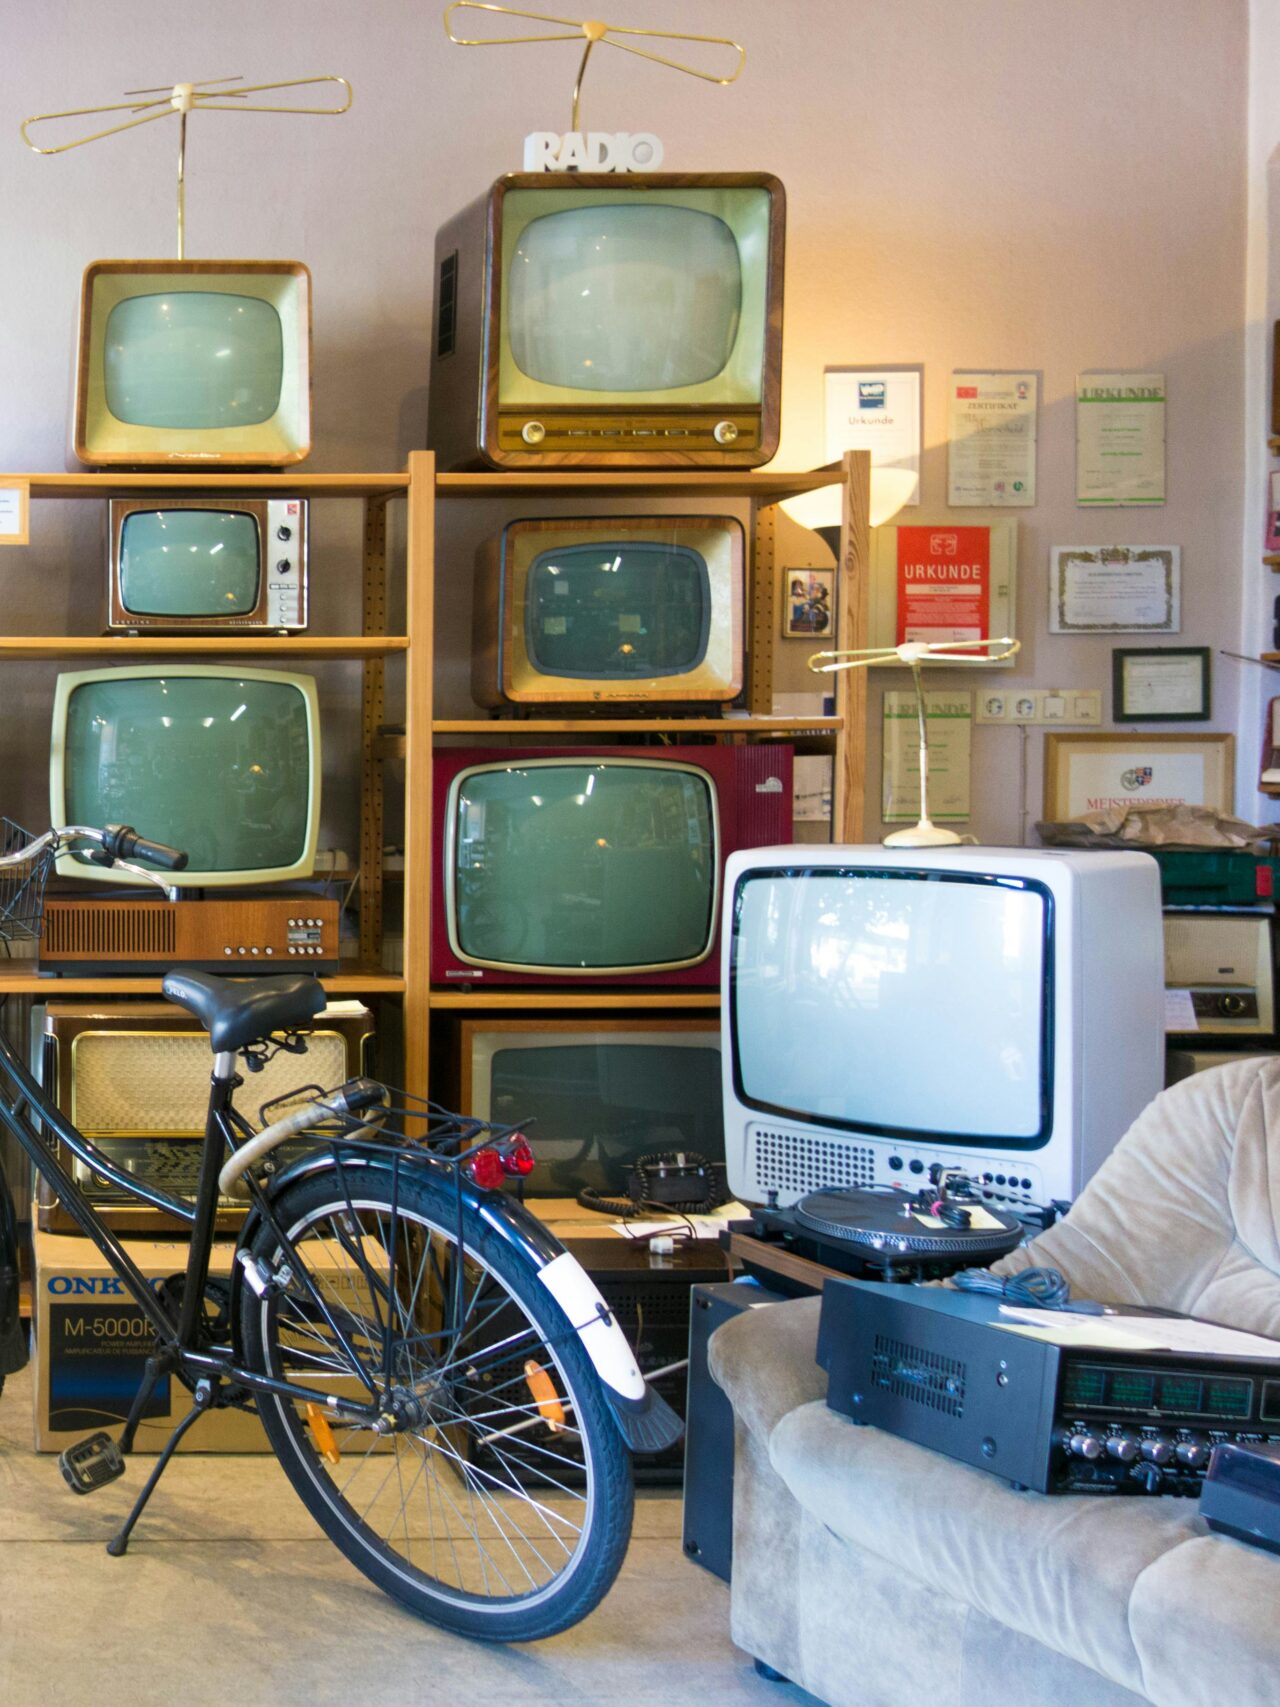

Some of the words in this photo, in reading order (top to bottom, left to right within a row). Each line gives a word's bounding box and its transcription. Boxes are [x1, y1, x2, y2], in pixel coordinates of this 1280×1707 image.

[523, 132, 664, 172] RADIO
[1081, 387, 1162, 398] URKUNDE
[848, 415, 895, 425] Urkunde
[904, 564, 981, 579] URKUNDE
